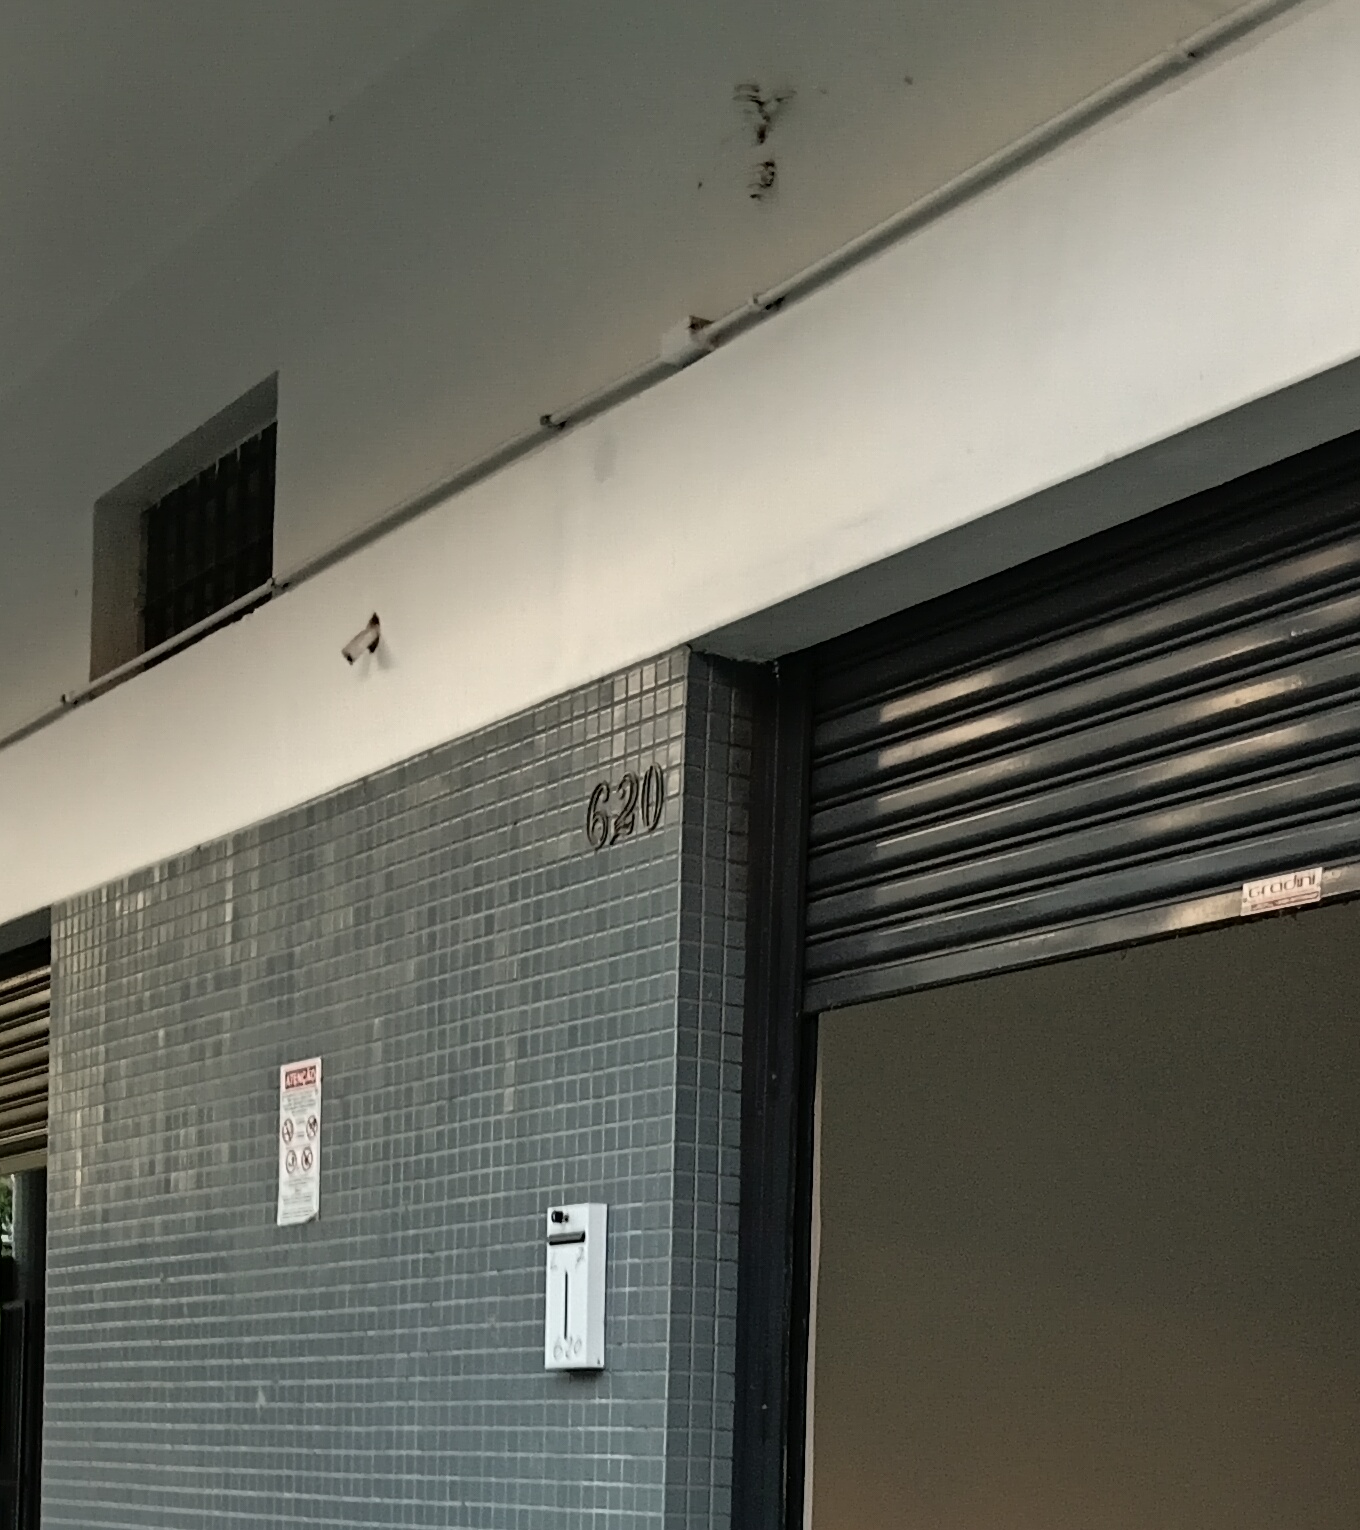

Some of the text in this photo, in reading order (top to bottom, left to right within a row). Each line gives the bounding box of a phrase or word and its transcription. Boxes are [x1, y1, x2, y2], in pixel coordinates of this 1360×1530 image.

[586, 762, 664, 851] 620
[1248, 874, 1316, 898] Gradini
[285, 1066, 316, 1088] ATENÇÃO
